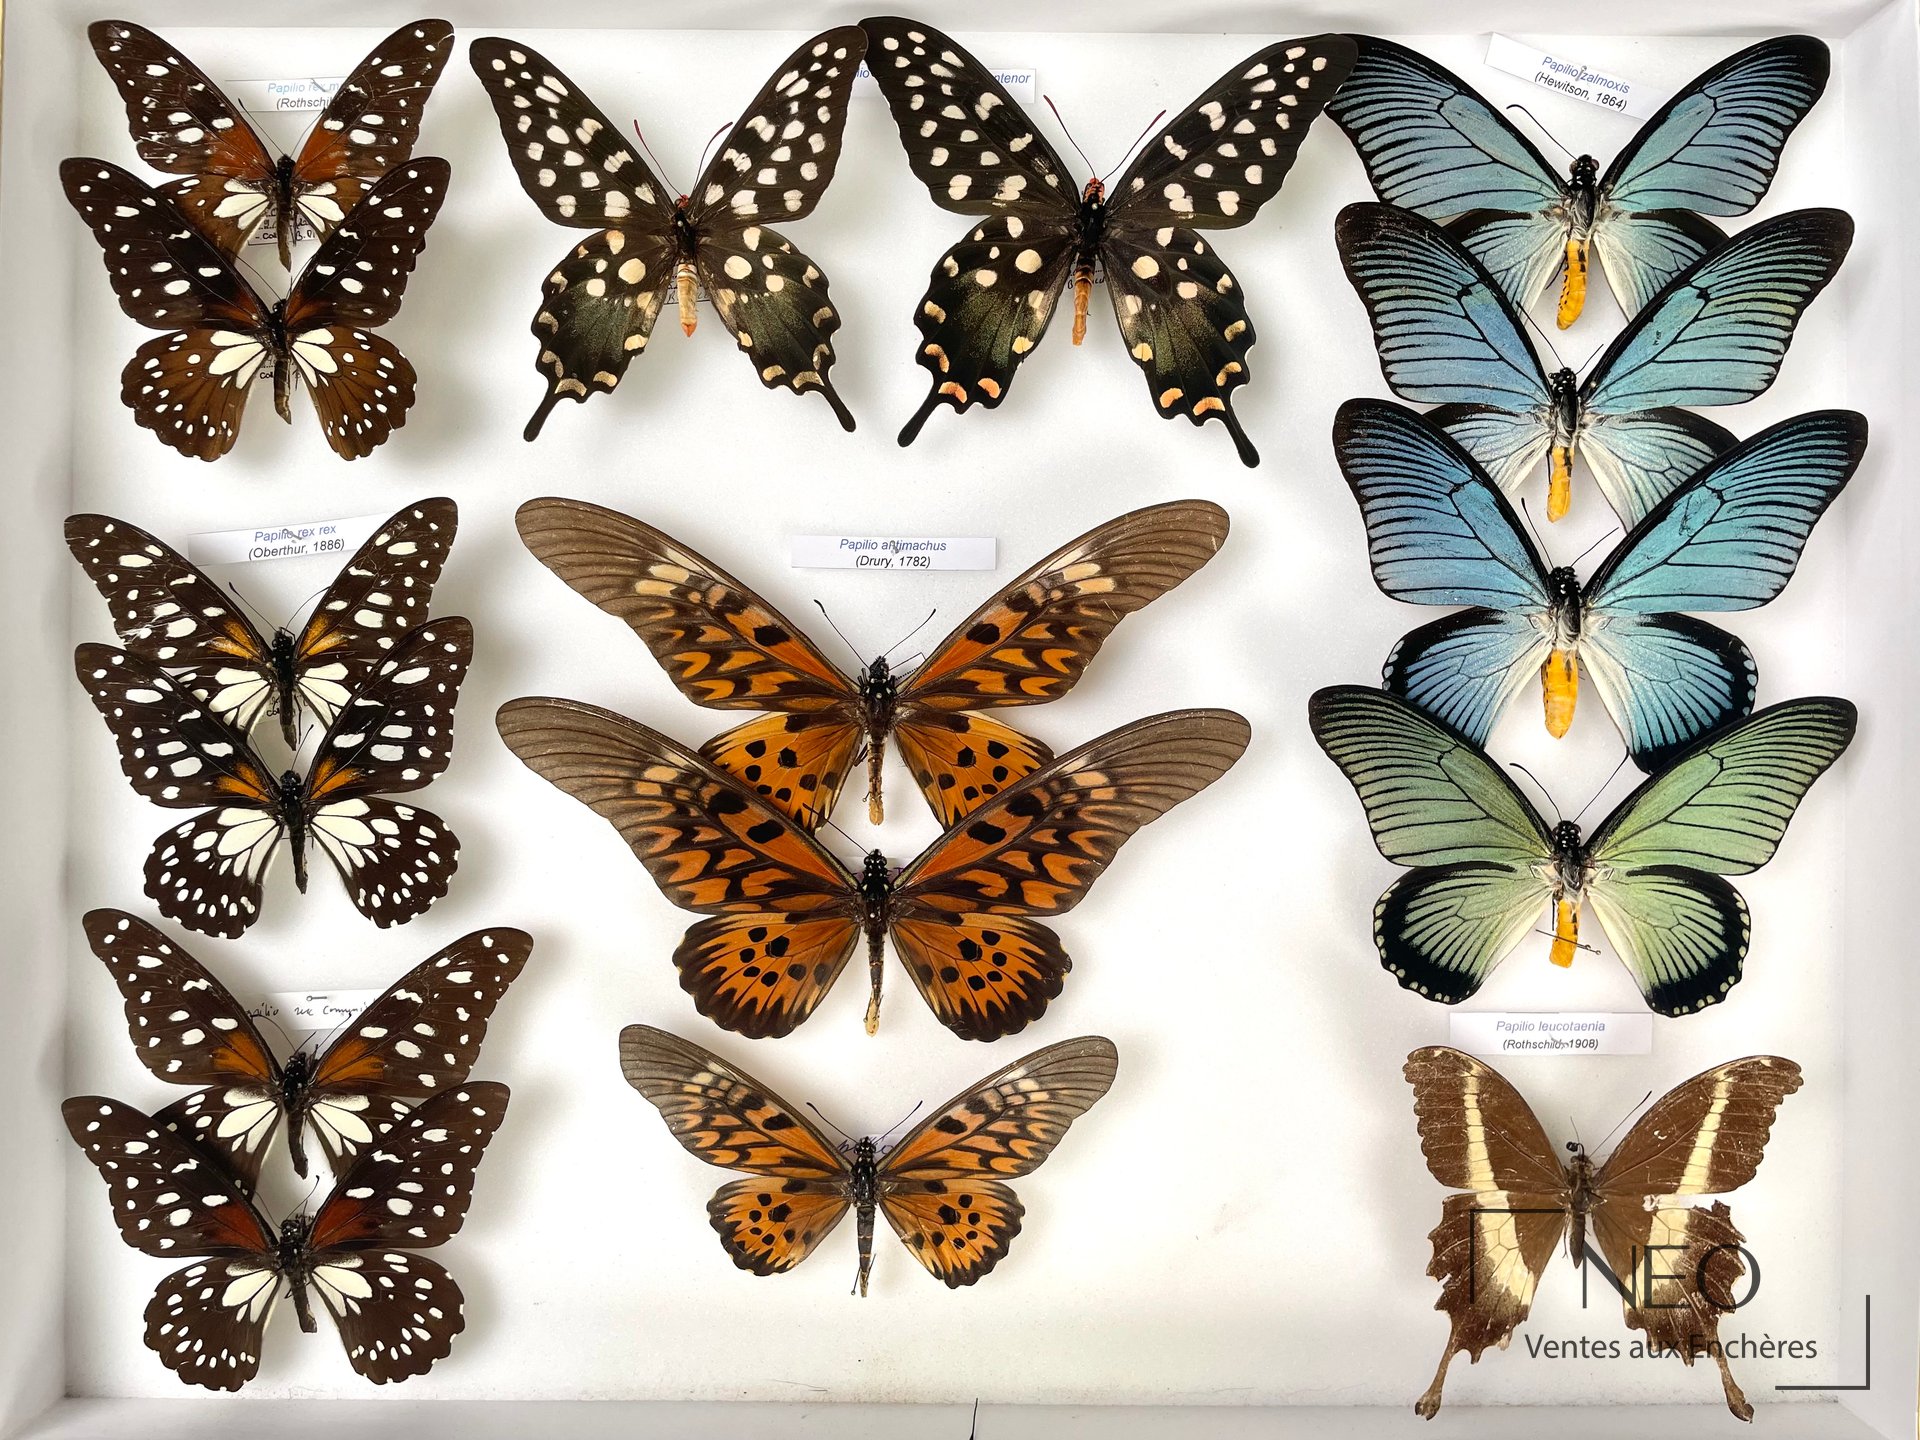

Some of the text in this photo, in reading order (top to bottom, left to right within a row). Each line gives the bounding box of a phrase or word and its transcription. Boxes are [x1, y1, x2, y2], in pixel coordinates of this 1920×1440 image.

[994, 73, 1031, 84] ntenor
[1541, 56, 1631, 94] Papilio zalmoxis
[267, 82, 305, 95] Papilio
[1534, 71, 1628, 112] (Hewitson, 1864)
[254, 524, 337, 543] Papilio rex rex
[248, 538, 345, 561] (Oberthur, 1886)
[839, 538, 878, 552] Papilio
[855, 555, 931, 568] (Drury, 1782)
[1496, 1020, 1606, 1033] Papilio leucotaenia
[1569, 1038, 1599, 1051] 1908)
